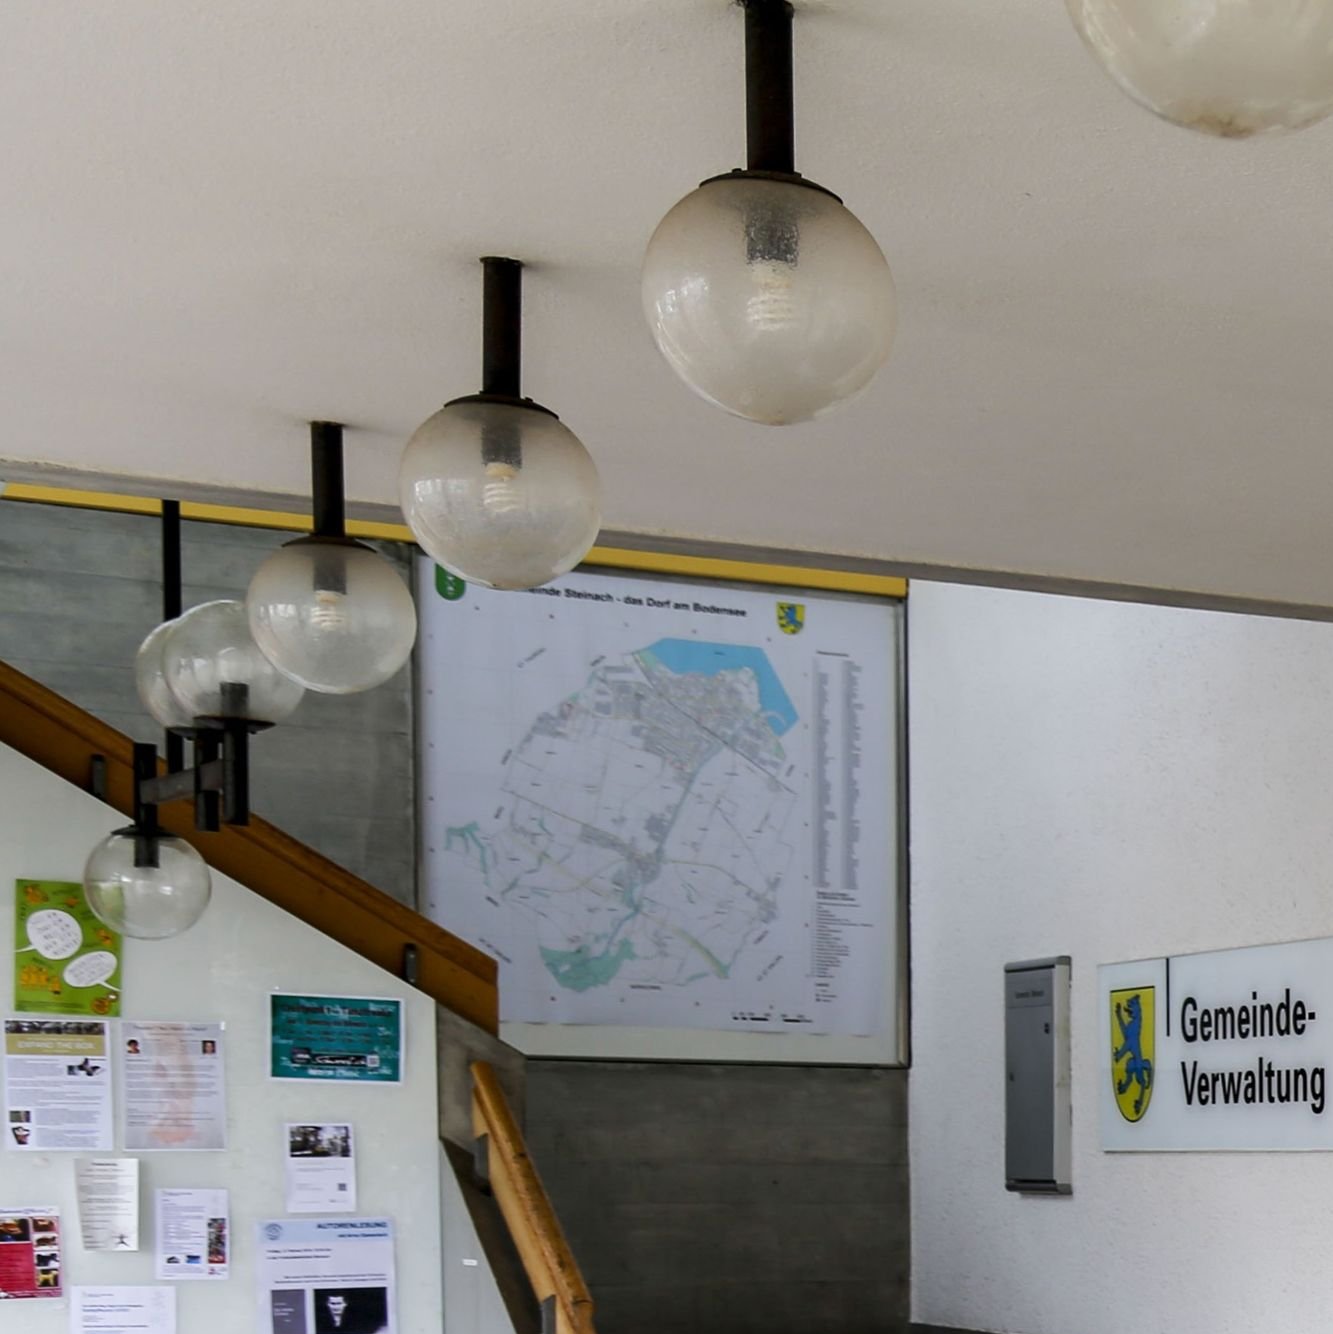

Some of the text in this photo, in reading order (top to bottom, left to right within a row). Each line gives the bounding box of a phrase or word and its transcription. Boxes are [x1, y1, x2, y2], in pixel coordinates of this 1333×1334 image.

[564, 588, 614, 603] Steinach
[623, 596, 643, 607] das
[646, 597, 671, 609] Dorf
[673, 602, 690, 611] am
[693, 603, 747, 617] Bodensee
[1180, 988, 1316, 1043] Gemeinde-
[1180, 1056, 1326, 1114] Verwaltung
